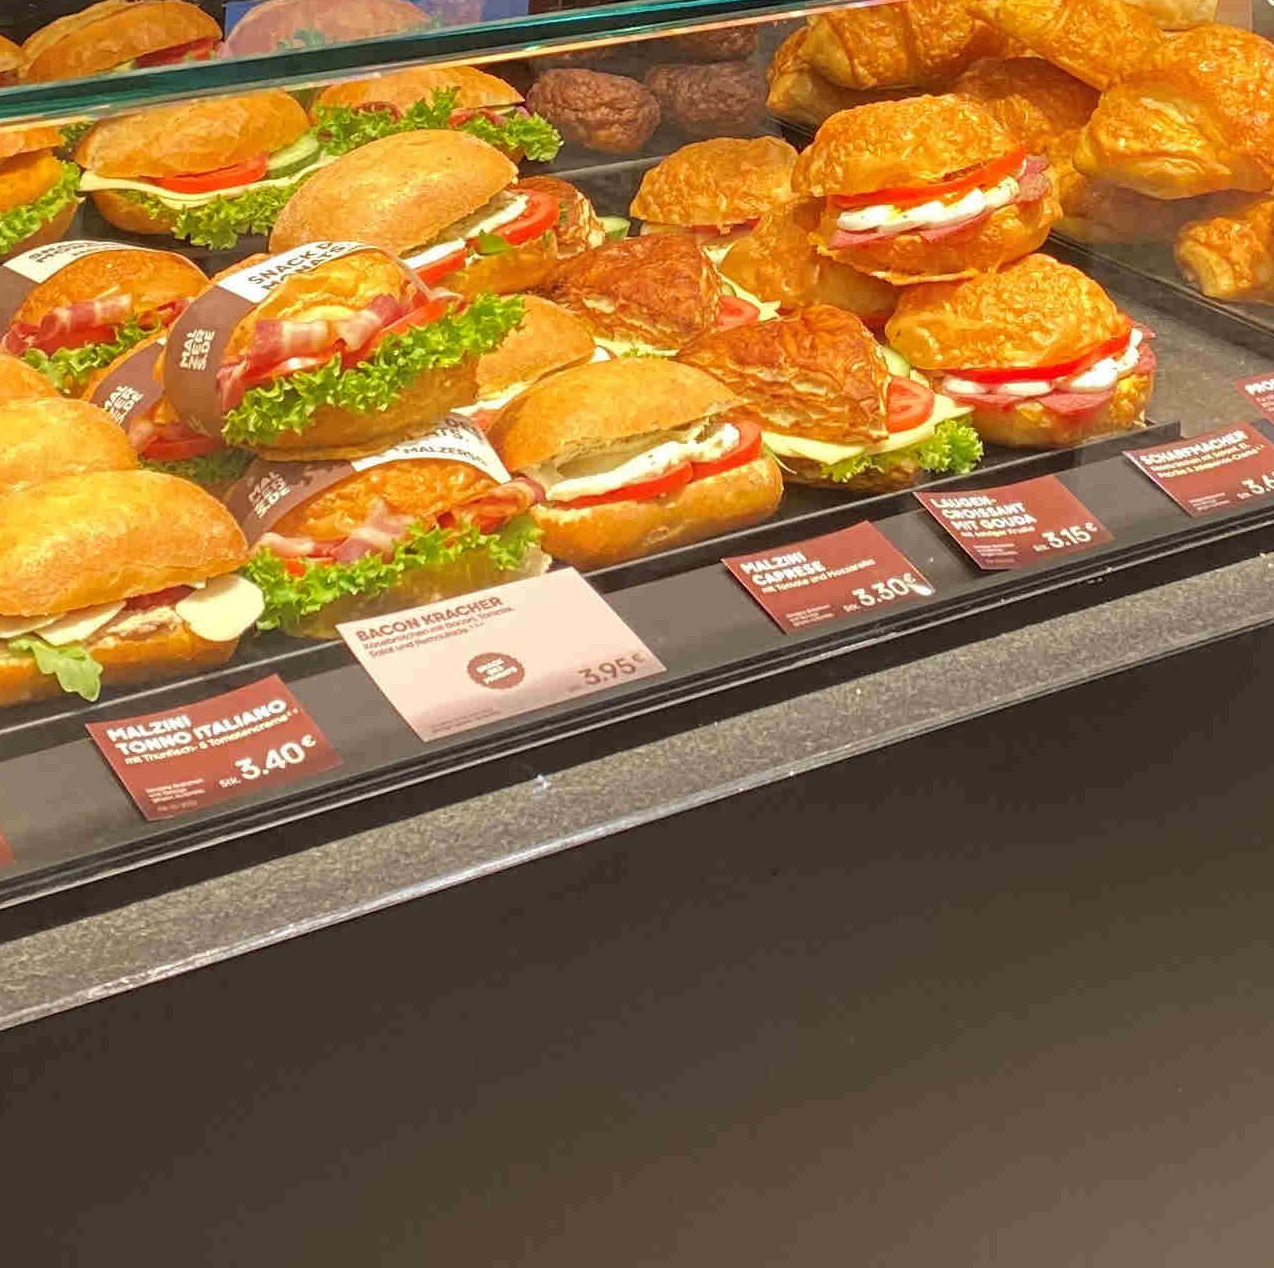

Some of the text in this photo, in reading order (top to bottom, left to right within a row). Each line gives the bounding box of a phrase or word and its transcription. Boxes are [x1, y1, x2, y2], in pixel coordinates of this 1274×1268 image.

[248, 250, 317, 285] SNACK
[1139, 430, 1249, 466] SCHARFMACHER
[930, 495, 998, 510] LAUGEN-
[941, 501, 1026, 522] CROISSANT
[951, 519, 979, 532] MIT
[979, 513, 1038, 531] GOUDA
[1041, 522, 1099, 550] 3.15€
[740, 550, 807, 575] MALZINI
[751, 560, 827, 587] CAPRESE
[852, 571, 917, 607] 3.30€
[355, 596, 504, 643] BACON KRACHER
[577, 652, 646, 687] 3.95€
[106, 714, 192, 744] MALZINI
[115, 698, 288, 757] TONNO ITALIANO
[234, 734, 317, 780] 3.40€
